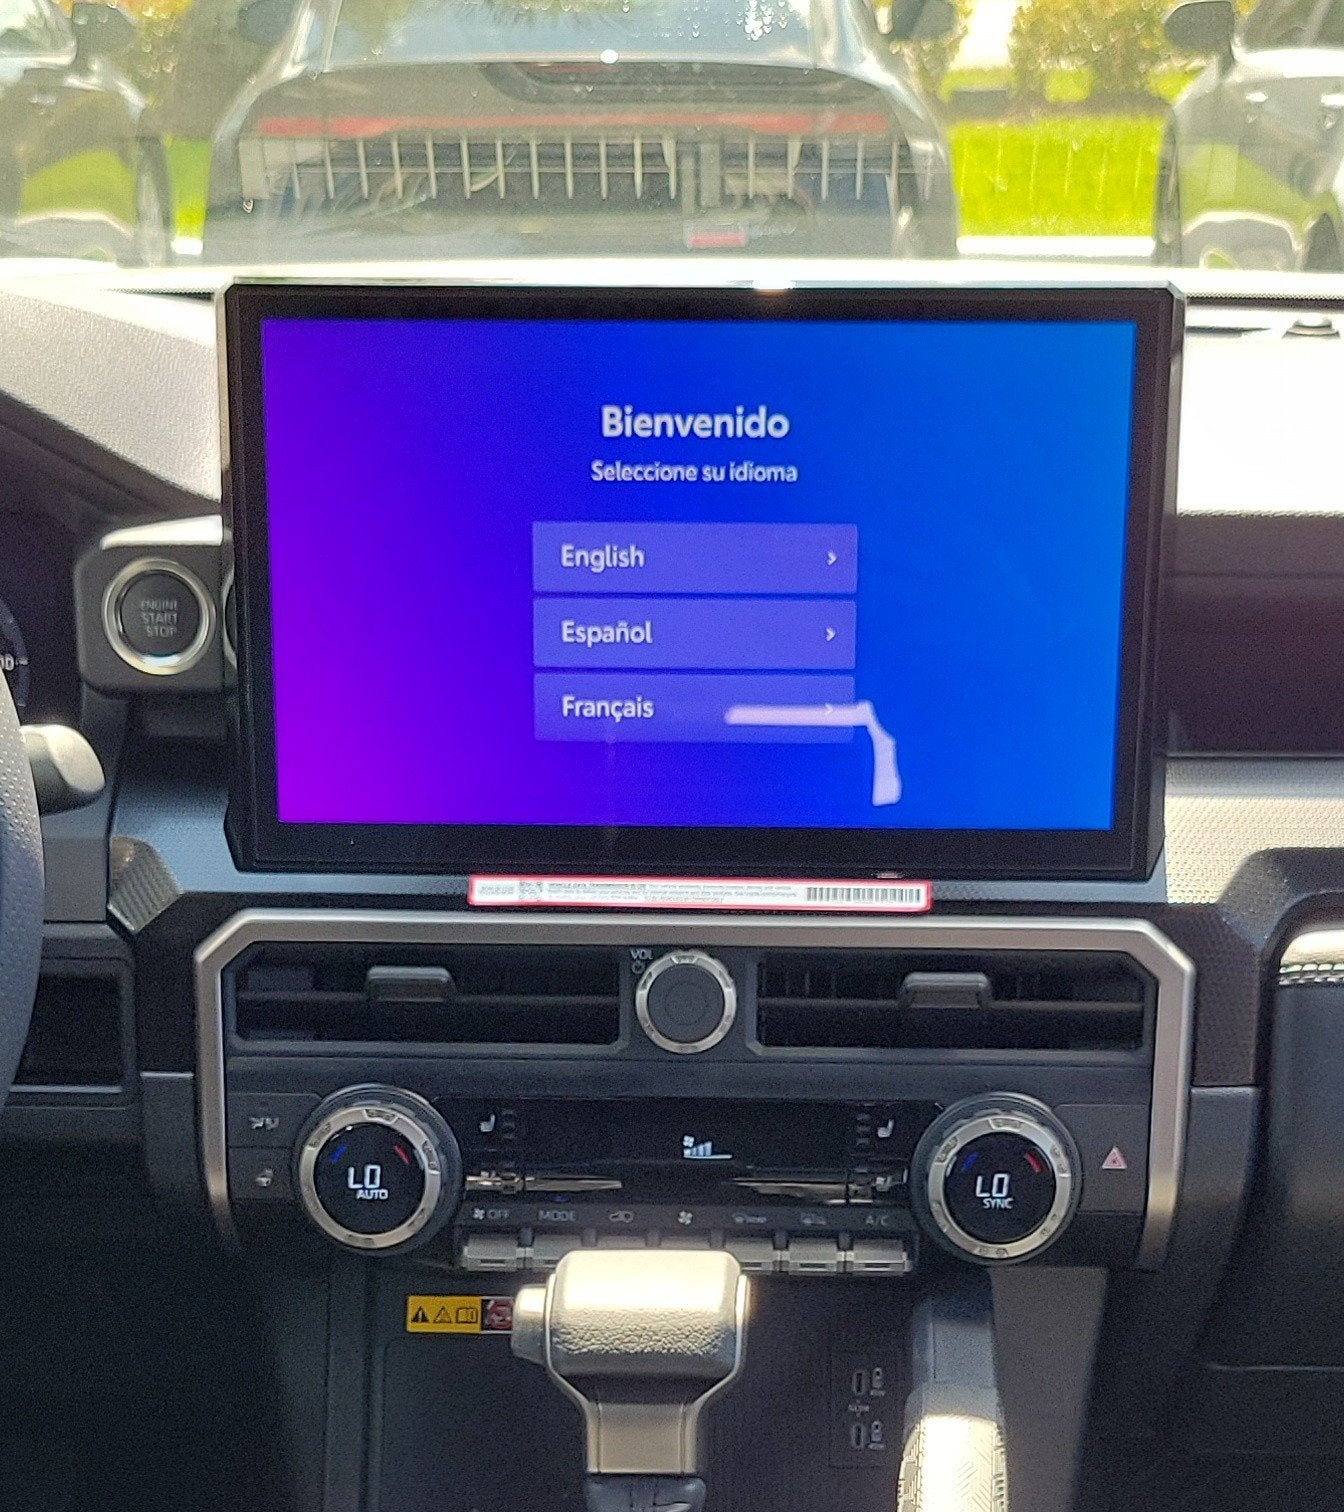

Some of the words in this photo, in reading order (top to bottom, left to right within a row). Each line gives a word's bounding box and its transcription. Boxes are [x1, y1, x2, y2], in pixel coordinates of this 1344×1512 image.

[601, 404, 790, 438] Bienvenido
[591, 459, 698, 482] Seleccione
[702, 464, 726, 482] su
[729, 460, 799, 482] idioma
[560, 544, 646, 573] English
[561, 620, 653, 648] Español
[562, 695, 654, 723] Français
[630, 947, 654, 961] VOL
[347, 1163, 382, 1190] LO
[974, 1172, 1012, 1199] LO
[357, 1189, 389, 1201] AUTO
[982, 1198, 1014, 1210] SYNC
[487, 1208, 510, 1220] OFF
[537, 1209, 577, 1222] MODE
[865, 1214, 889, 1226] A/C
